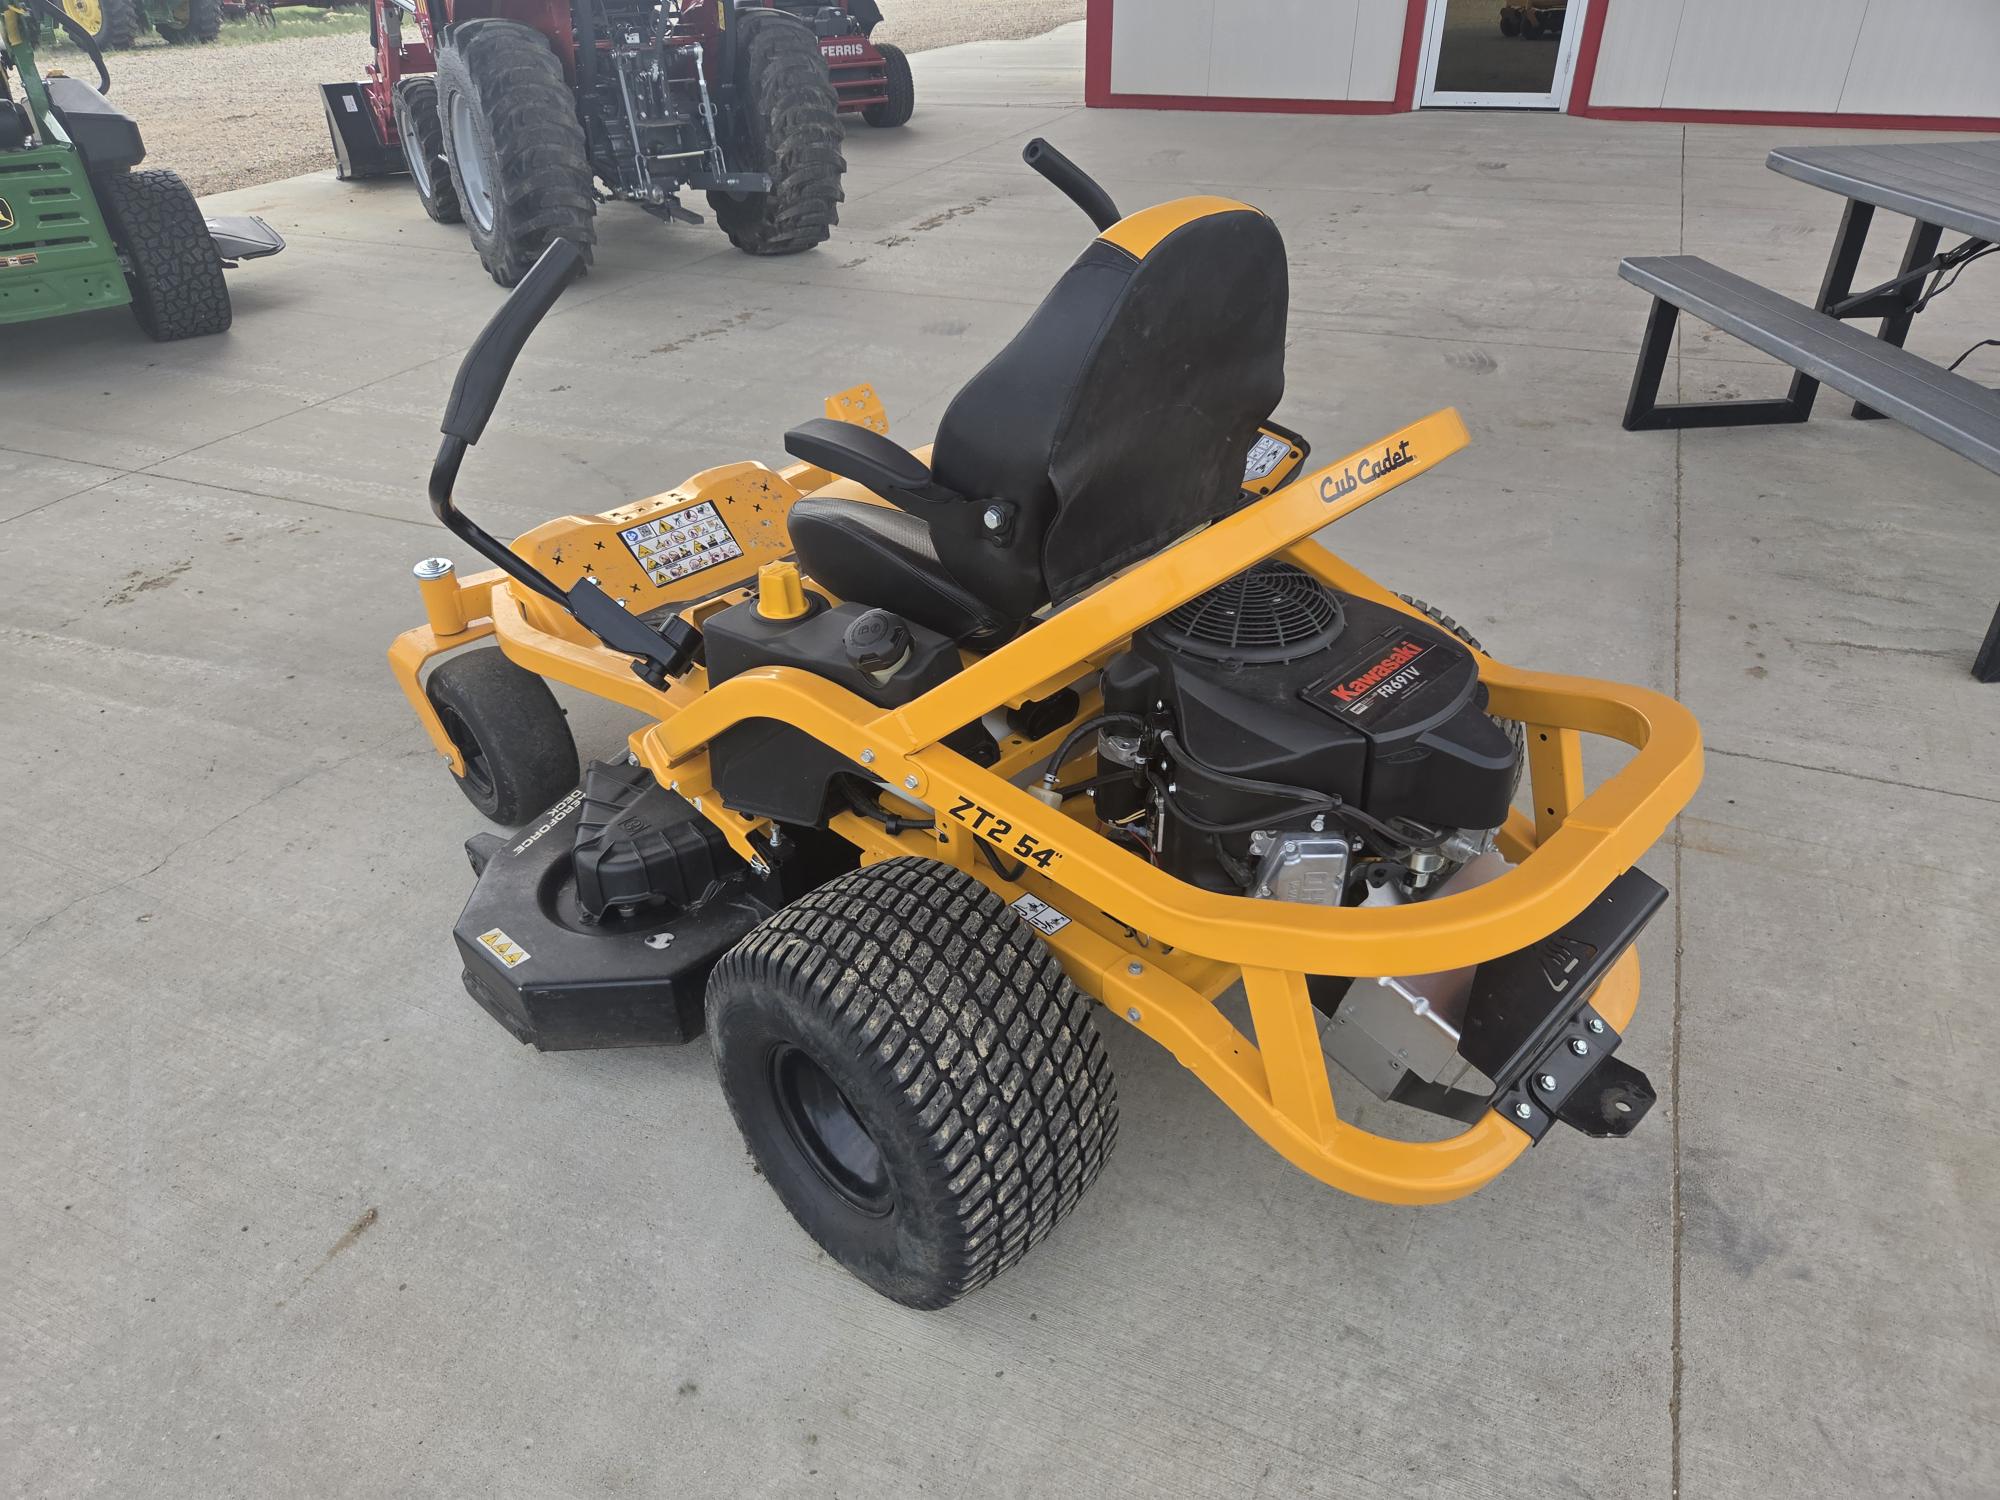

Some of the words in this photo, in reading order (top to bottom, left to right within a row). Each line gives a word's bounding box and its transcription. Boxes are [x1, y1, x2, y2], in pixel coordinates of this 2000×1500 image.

[820, 43, 864, 57] FERRIS
[1320, 467, 1358, 503] Cub
[1357, 440, 1414, 485] Cadet
[1330, 640, 1424, 702] Kawasaki
[1376, 665, 1421, 698] FR691V
[547, 789, 583, 817] DECK
[948, 795, 1012, 844] ZT2
